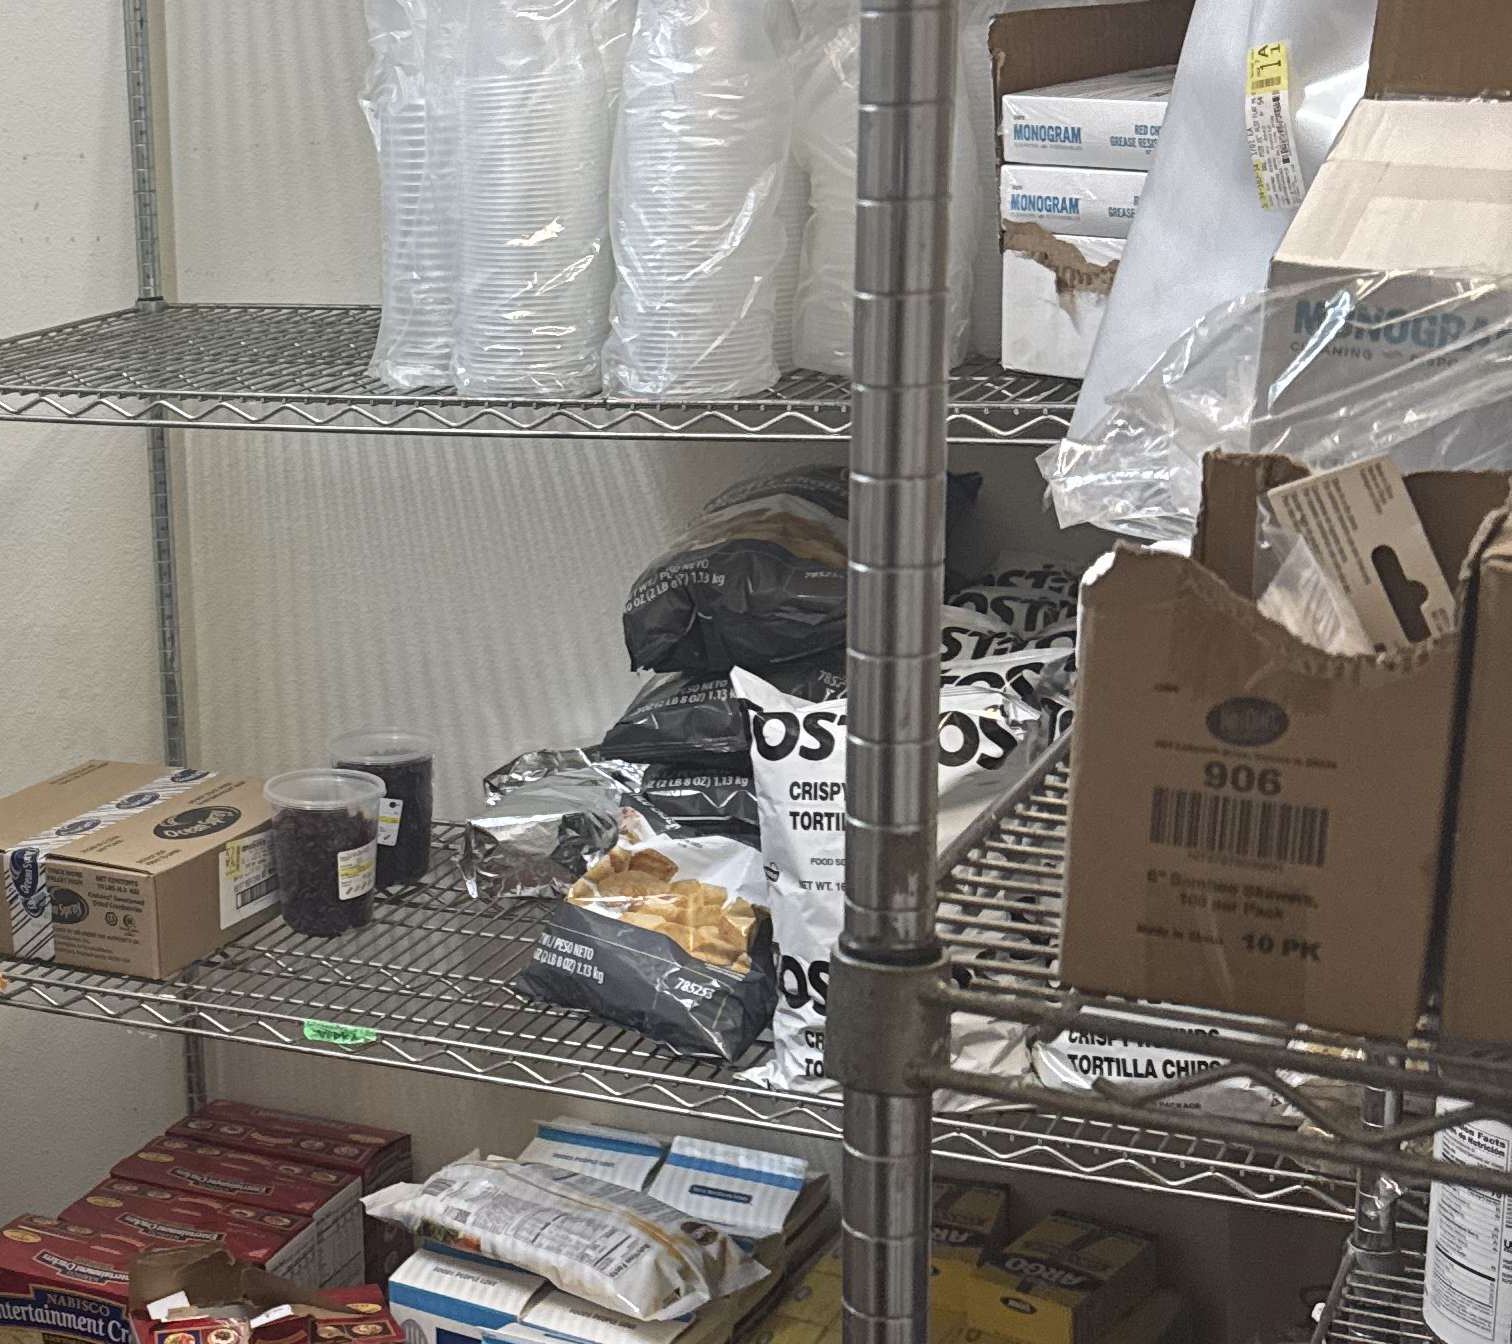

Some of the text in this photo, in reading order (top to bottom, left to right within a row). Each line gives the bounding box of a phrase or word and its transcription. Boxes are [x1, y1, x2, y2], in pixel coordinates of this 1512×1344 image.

[1014, 124, 1081, 144] MONOGRAM
[1011, 194, 1080, 214] MONOGRAM
[713, 776, 733, 787] 1.13
[1204, 761, 1281, 796] 906
[811, 857, 829, 866] FOOD
[1243, 932, 1320, 961] 10 PK
[577, 962, 591, 978] 1.13
[1068, 1055, 1157, 1078] TORTILLA
[46, 1293, 111, 1317] NABISCO
